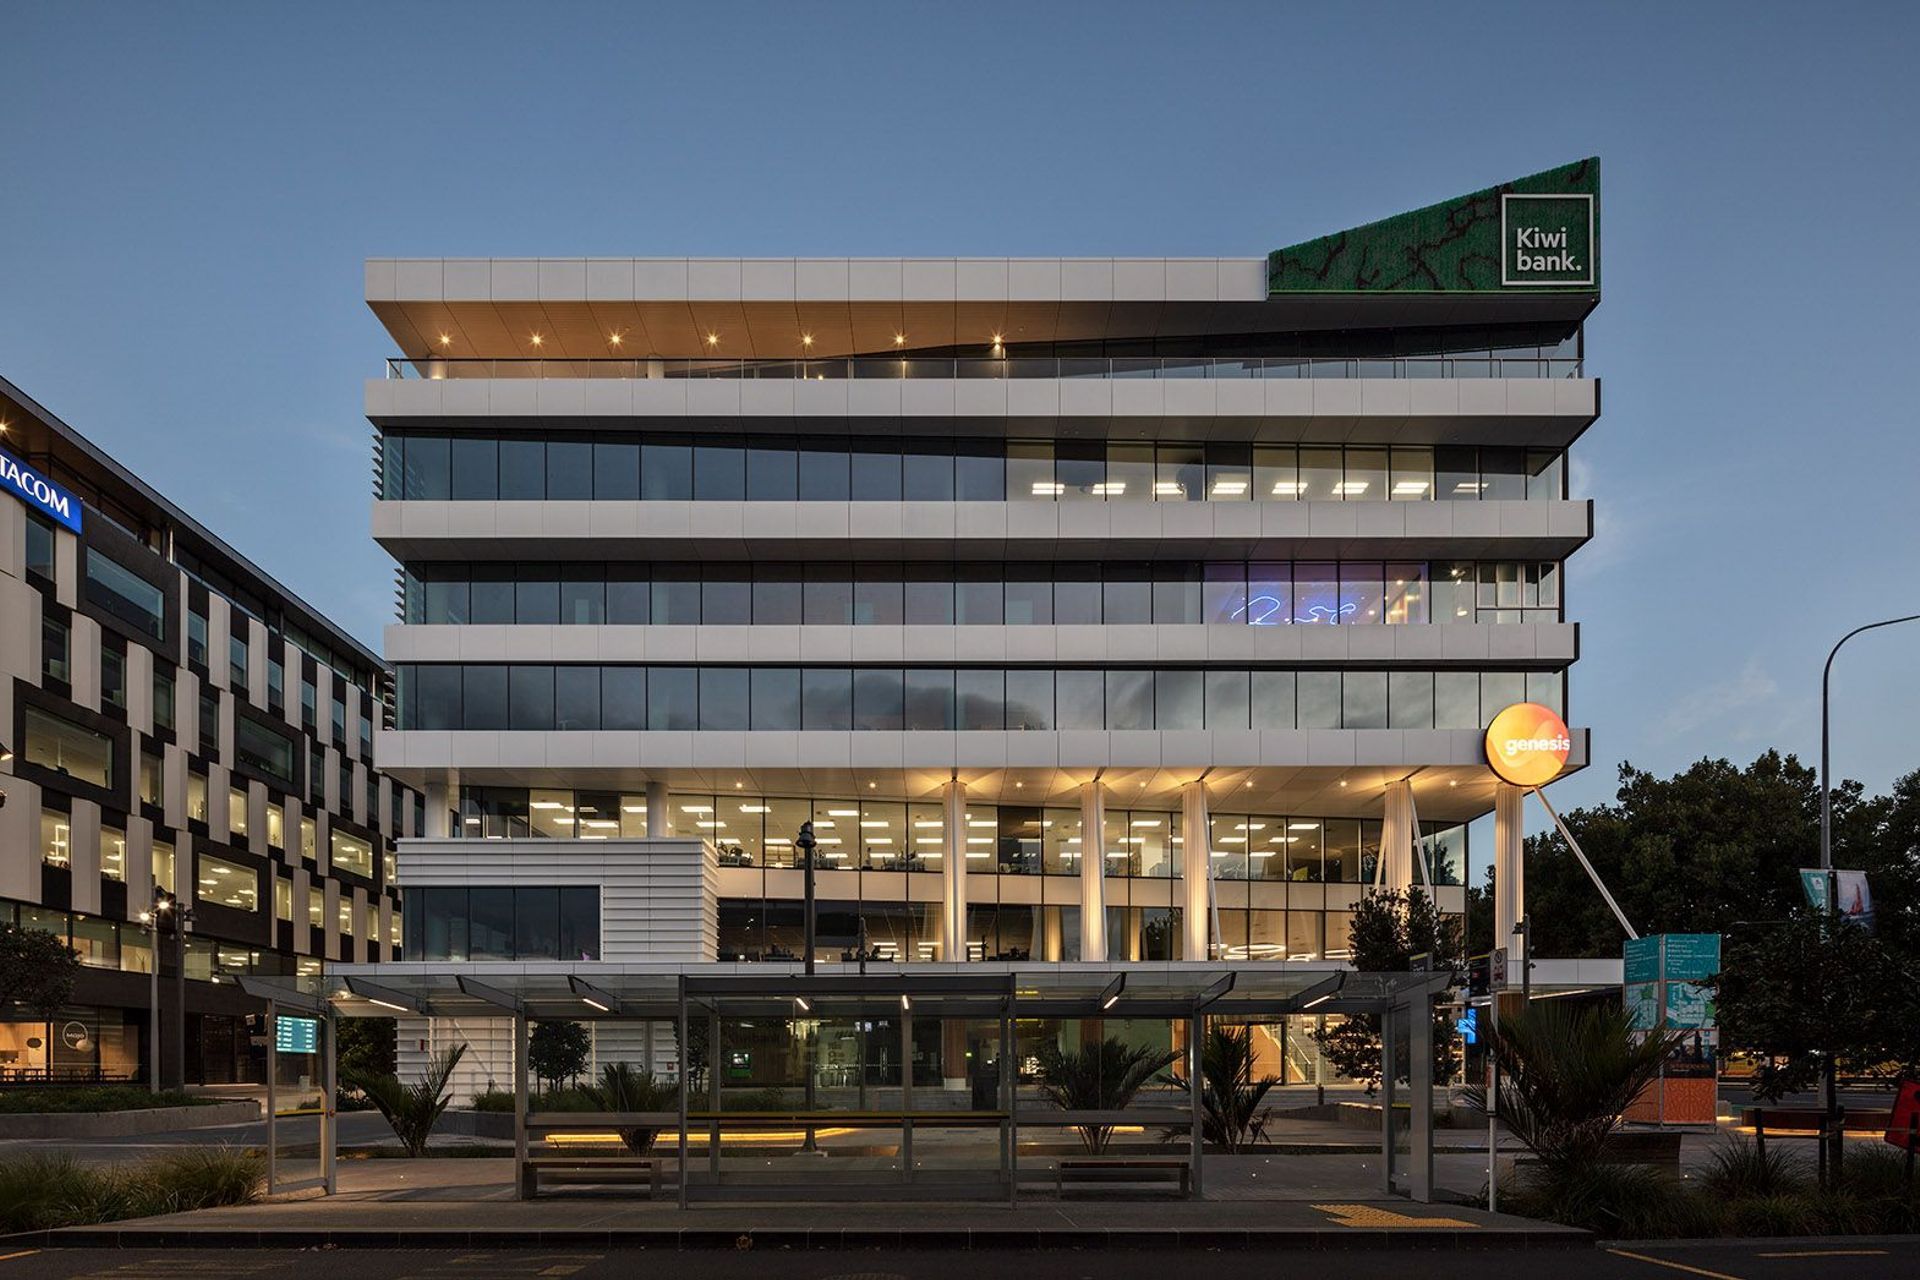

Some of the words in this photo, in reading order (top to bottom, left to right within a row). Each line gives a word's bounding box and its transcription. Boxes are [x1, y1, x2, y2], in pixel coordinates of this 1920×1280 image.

[1516, 226, 1567, 248] Kiwi
[1516, 249, 1582, 271] bank.
[0, 454, 70, 518] TACOM
[1505, 734, 1571, 756] genesis
